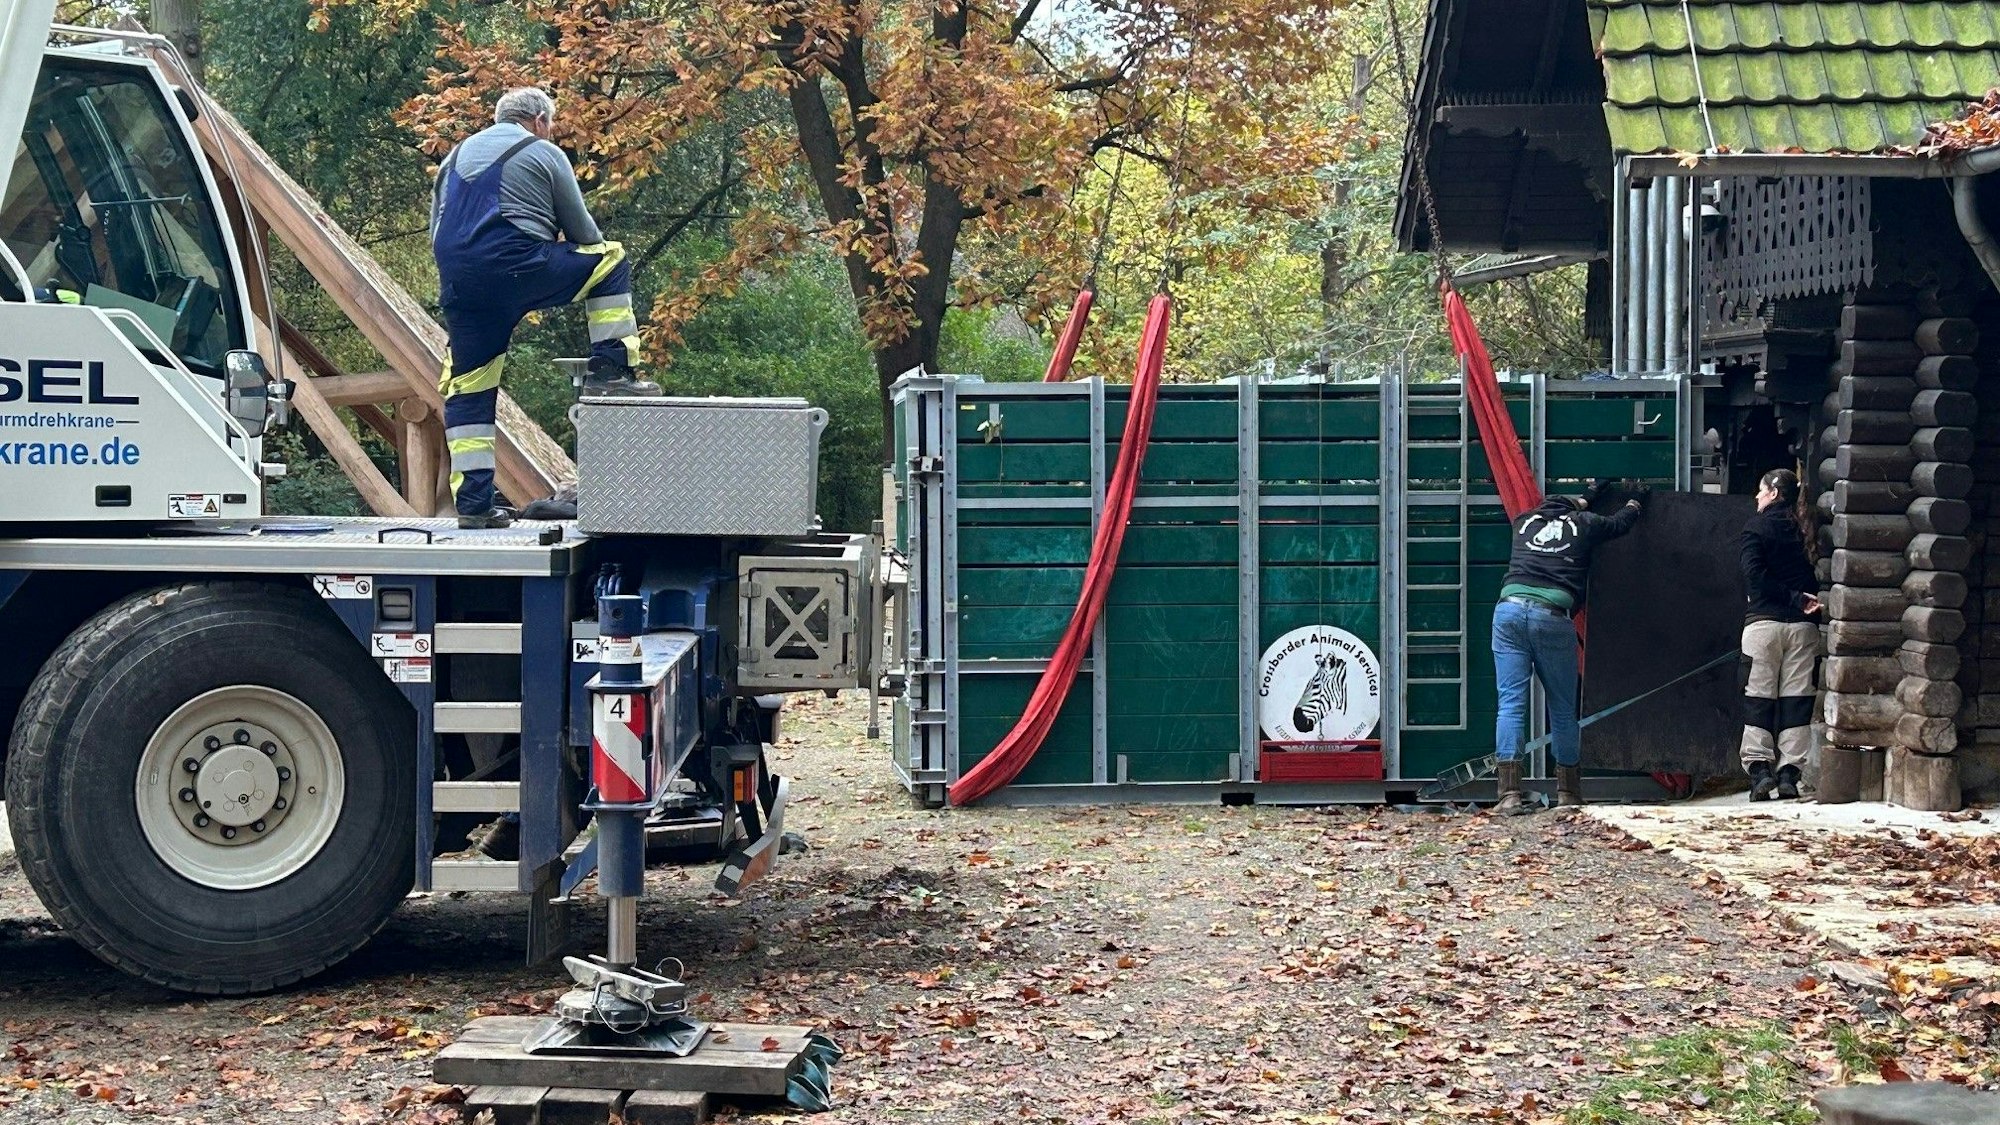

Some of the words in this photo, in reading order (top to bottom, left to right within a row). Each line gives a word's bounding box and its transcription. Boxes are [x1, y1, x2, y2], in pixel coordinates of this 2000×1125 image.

[1259, 638, 1306, 697] Crossborder
[1310, 633, 1357, 654] Animal
[1354, 650, 1379, 697] Services
[610, 697, 625, 719] 4
